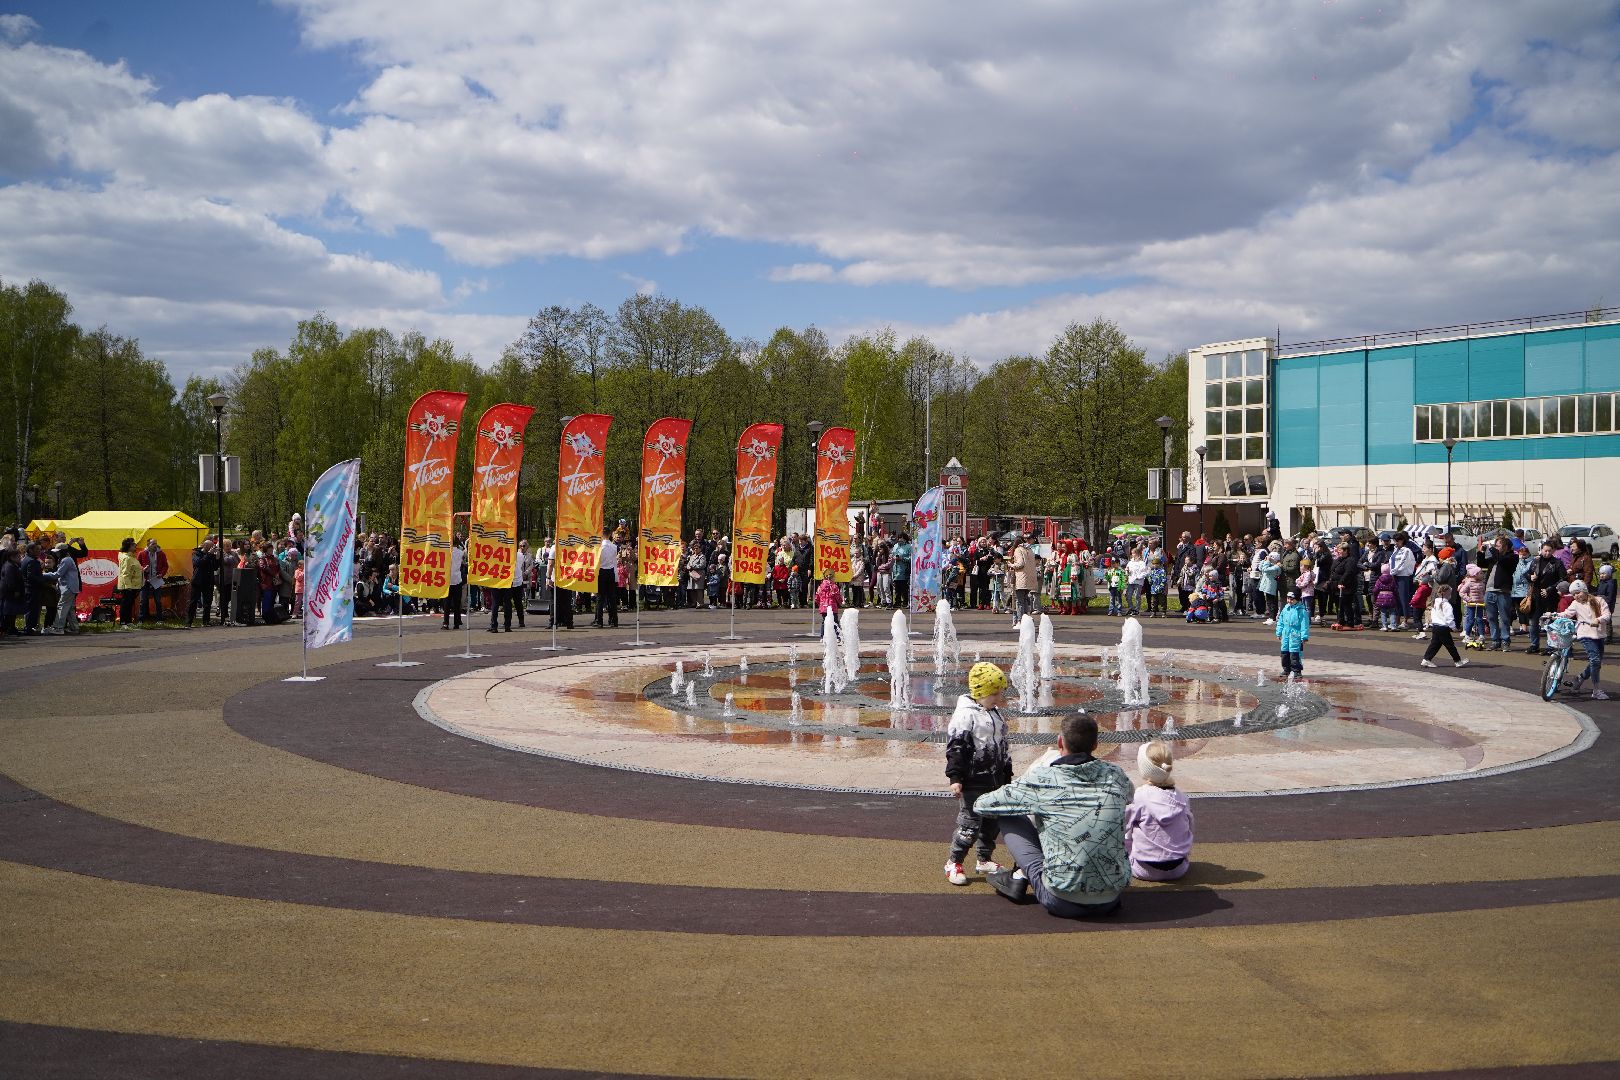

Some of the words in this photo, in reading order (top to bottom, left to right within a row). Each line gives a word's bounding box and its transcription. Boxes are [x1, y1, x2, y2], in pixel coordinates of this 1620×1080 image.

[405, 548, 445, 569] 1941
[475, 542, 510, 563] 1941
[561, 545, 595, 566] 1941
[645, 545, 675, 562] 1941
[736, 544, 764, 560] 1941
[819, 544, 847, 559] 1941
[923, 539, 934, 560] 9
[472, 560, 511, 580] 1945
[559, 564, 596, 583] 1945
[643, 561, 675, 577] 1945
[734, 559, 763, 574] 1945
[818, 558, 850, 574] 1945
[402, 567, 446, 588] 1945
[308, 599, 325, 620] С
